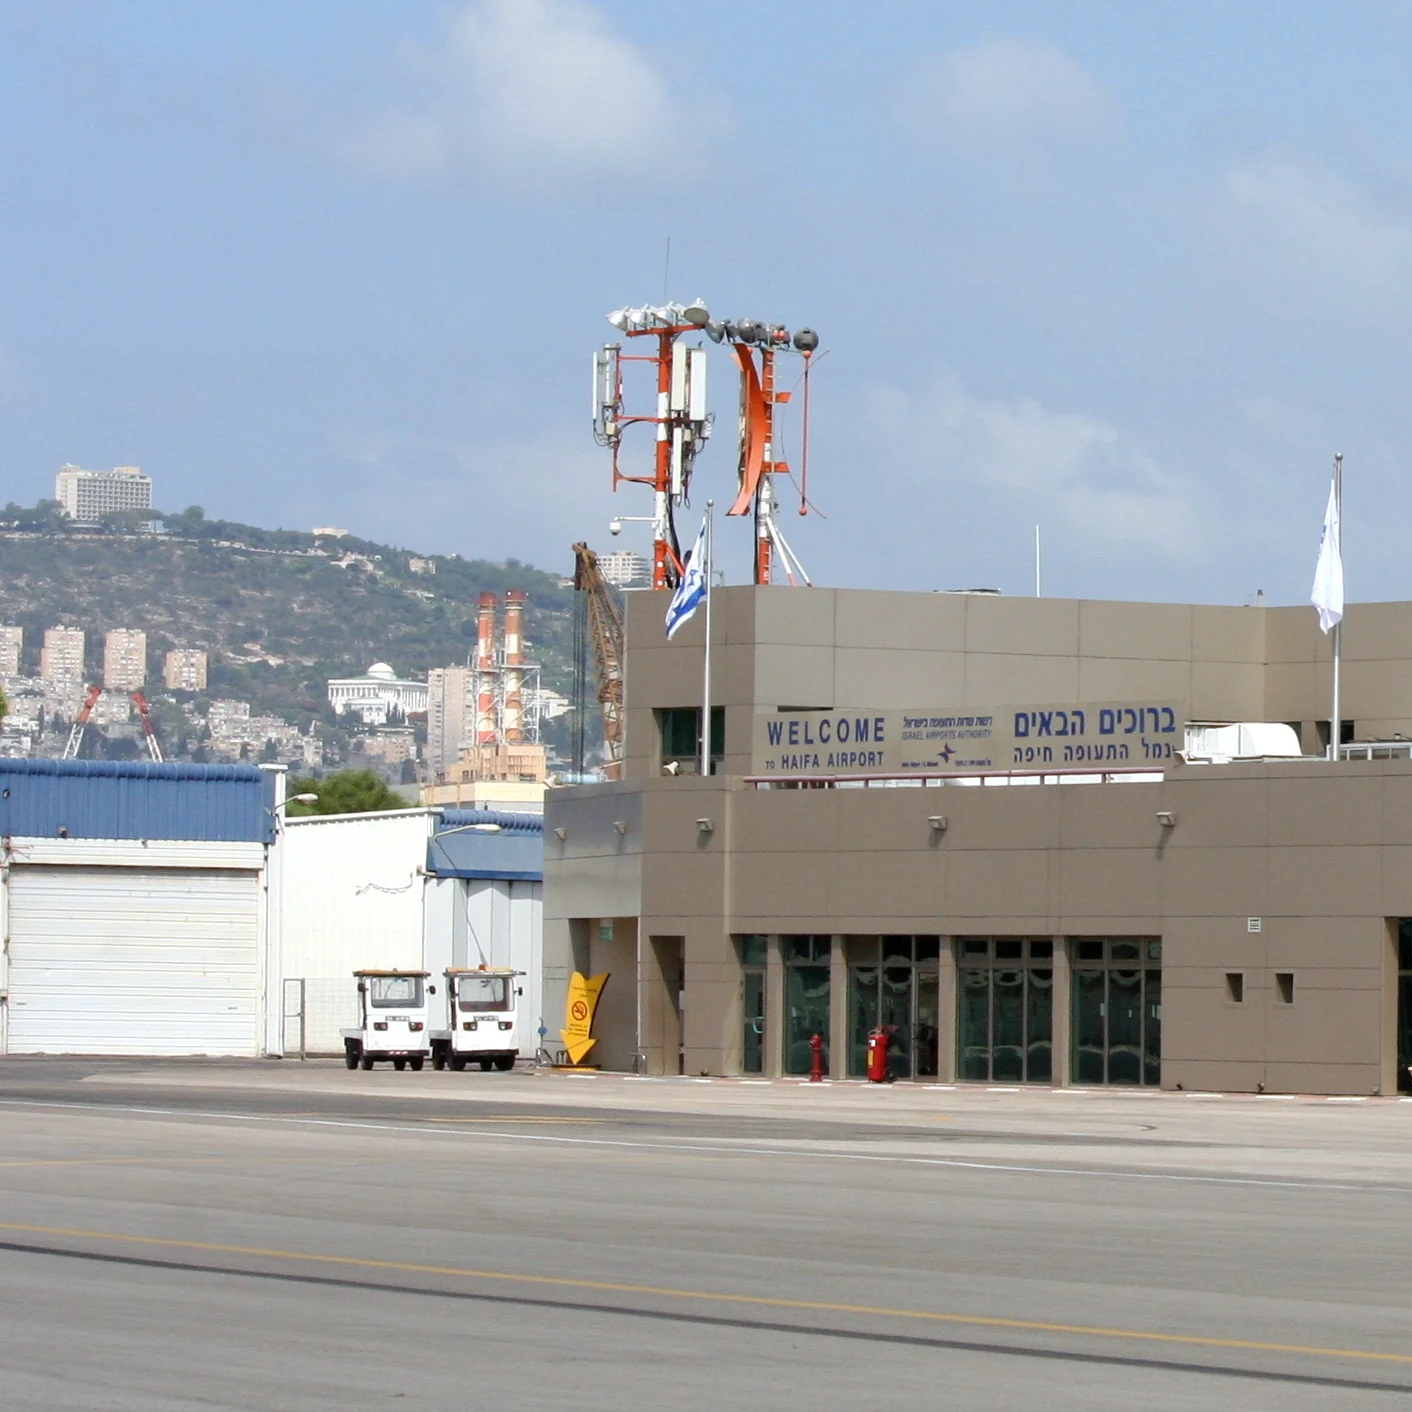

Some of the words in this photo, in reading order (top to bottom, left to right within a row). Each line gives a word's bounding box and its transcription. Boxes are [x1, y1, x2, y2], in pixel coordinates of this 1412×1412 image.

[767, 717, 885, 745] WELCOME
[1014, 710, 1086, 738] הבאים
[1099, 706, 1176, 735] ברוכים
[765, 760, 776, 770] TO
[781, 753, 820, 769] HAIFA
[827, 751, 884, 768] AIRPORT
[1014, 746, 1053, 763] חיפה
[1064, 743, 1129, 762] התעופה
